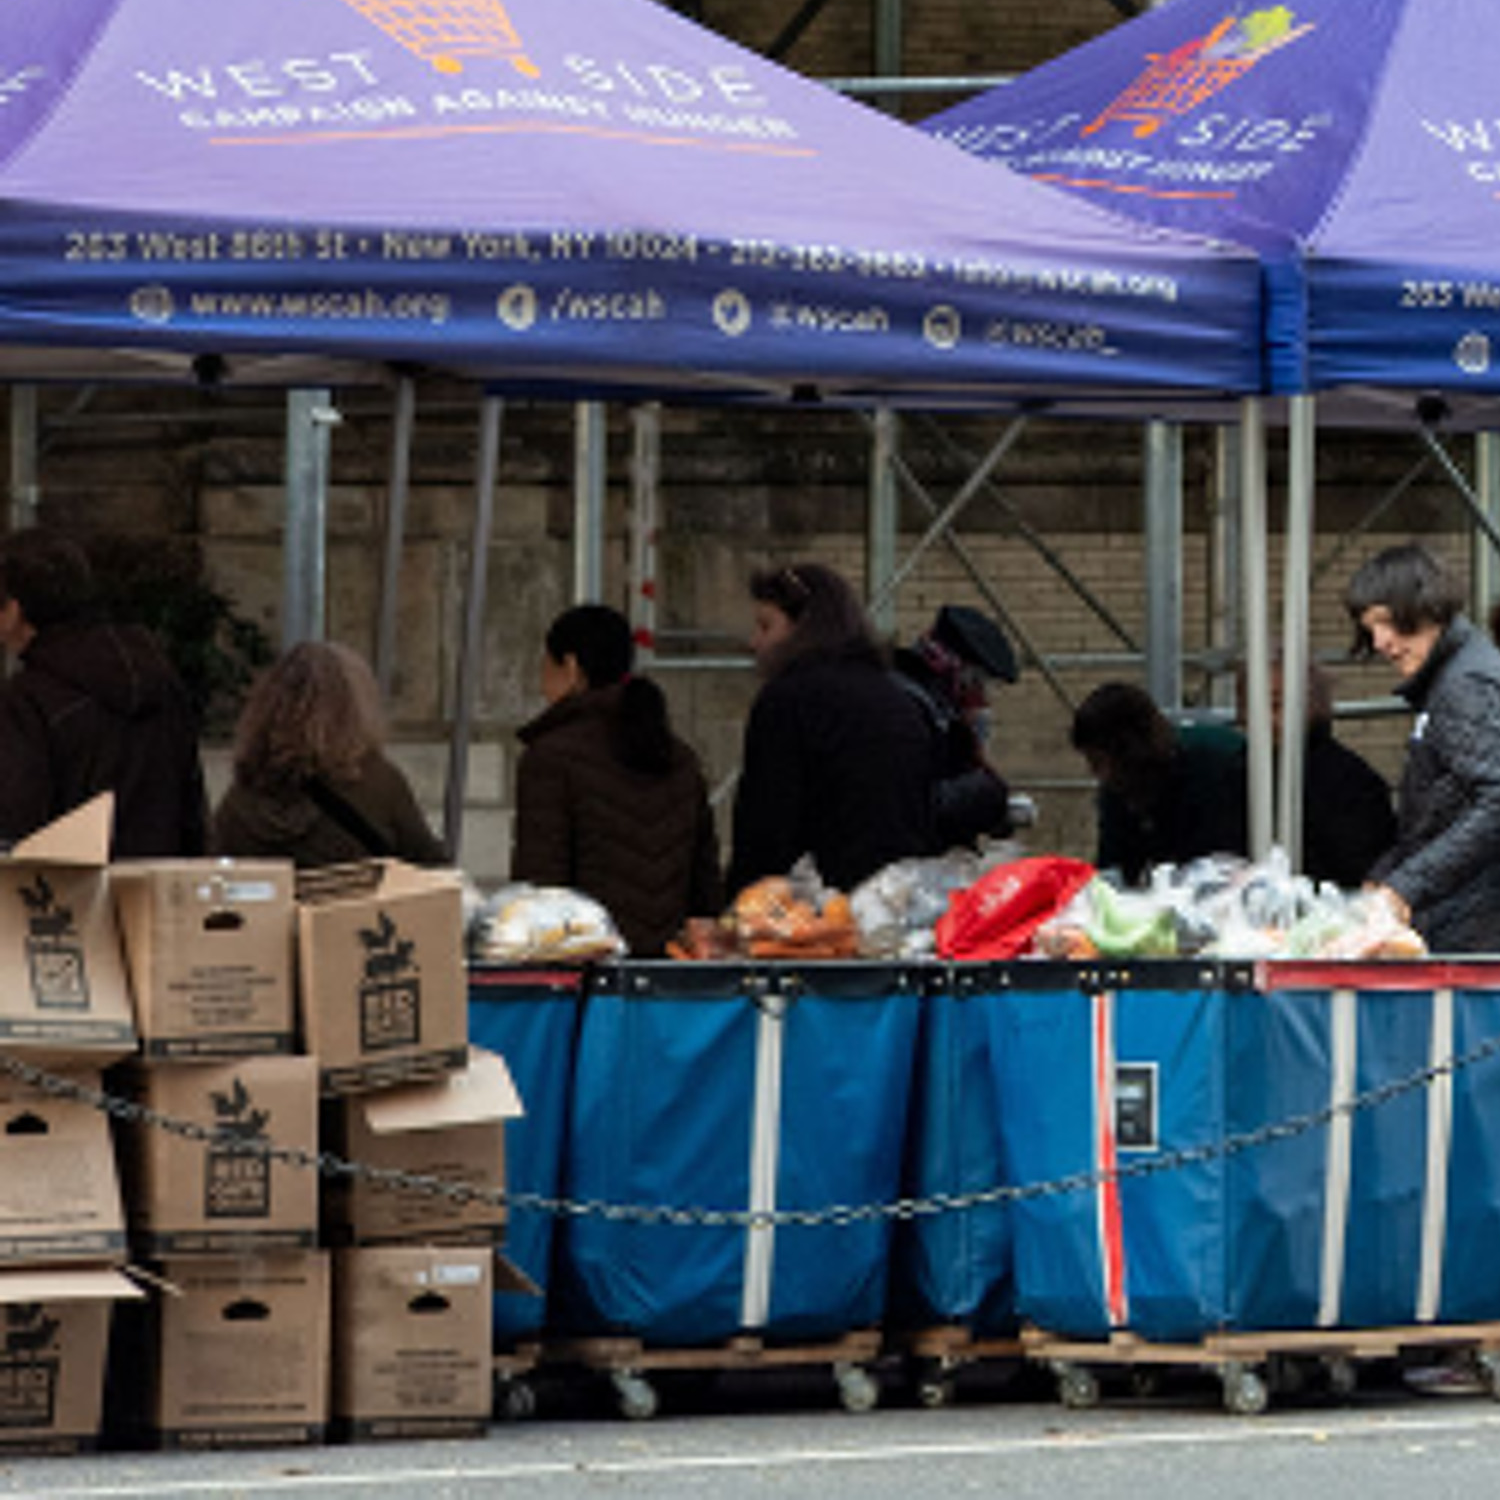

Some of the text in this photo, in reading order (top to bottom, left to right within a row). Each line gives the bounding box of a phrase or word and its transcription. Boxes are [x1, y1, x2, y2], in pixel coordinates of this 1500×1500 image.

[135, 50, 768, 109] WEST SIDE
[180, 98, 416, 128] CAMPAIGN
[434, 88, 609, 119] AGAINST
[1178, 112, 1332, 152] SIDE
[137, 232, 220, 261] West
[315, 231, 348, 260] St
[382, 232, 452, 260] New
[462, 231, 541, 263] York,
[550, 231, 595, 259] NY
[604, 231, 699, 264] 10024
[189, 286, 450, 327] www.wscah.org
[550, 287, 667, 322] /wscah
